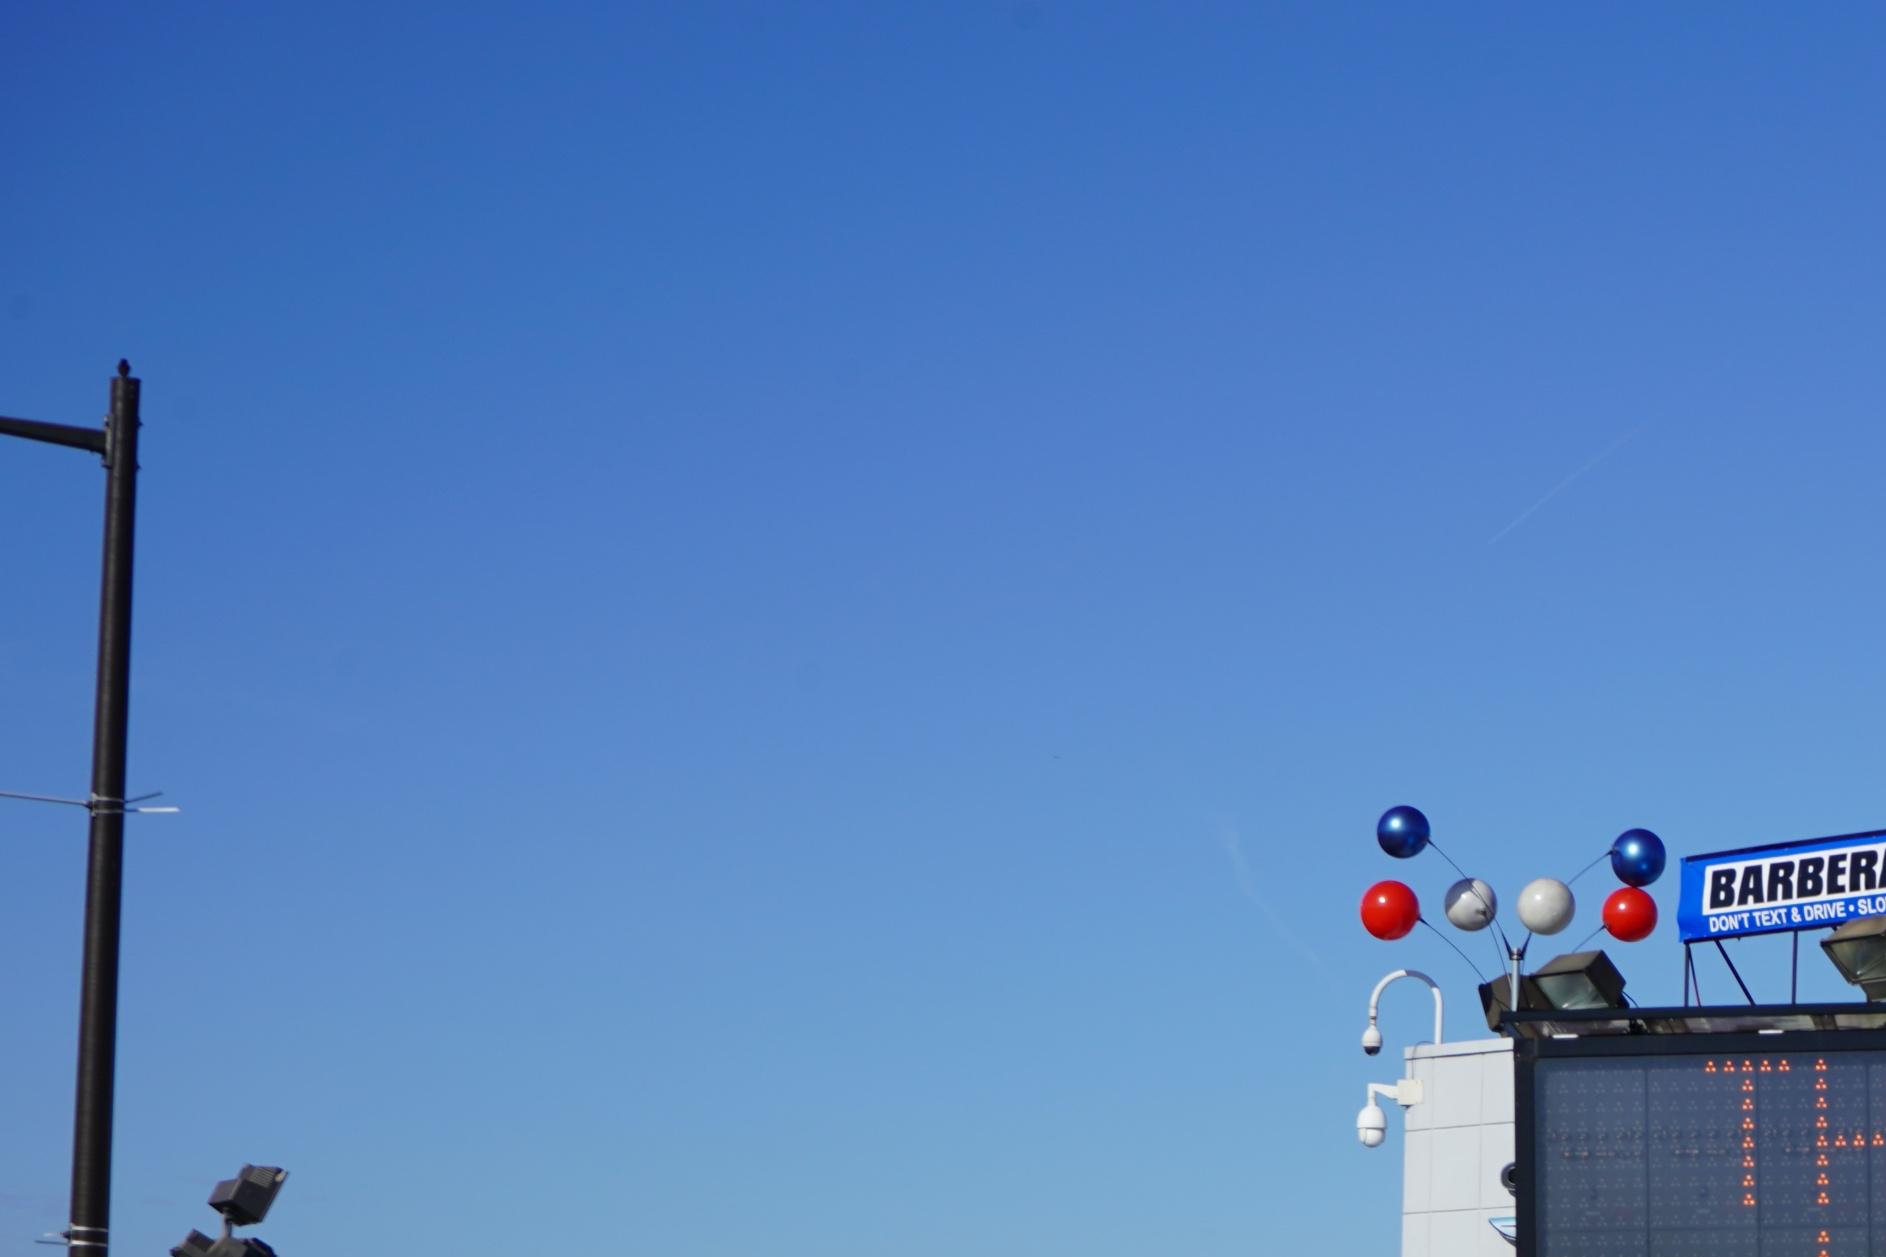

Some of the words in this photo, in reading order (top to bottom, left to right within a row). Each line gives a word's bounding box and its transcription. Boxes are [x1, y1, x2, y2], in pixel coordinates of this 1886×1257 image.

[1709, 912, 1750, 932] DON'T
[1753, 908, 1787, 928] TEXT
[1791, 907, 1802, 922] &
[1804, 901, 1846, 921] DRIVE
